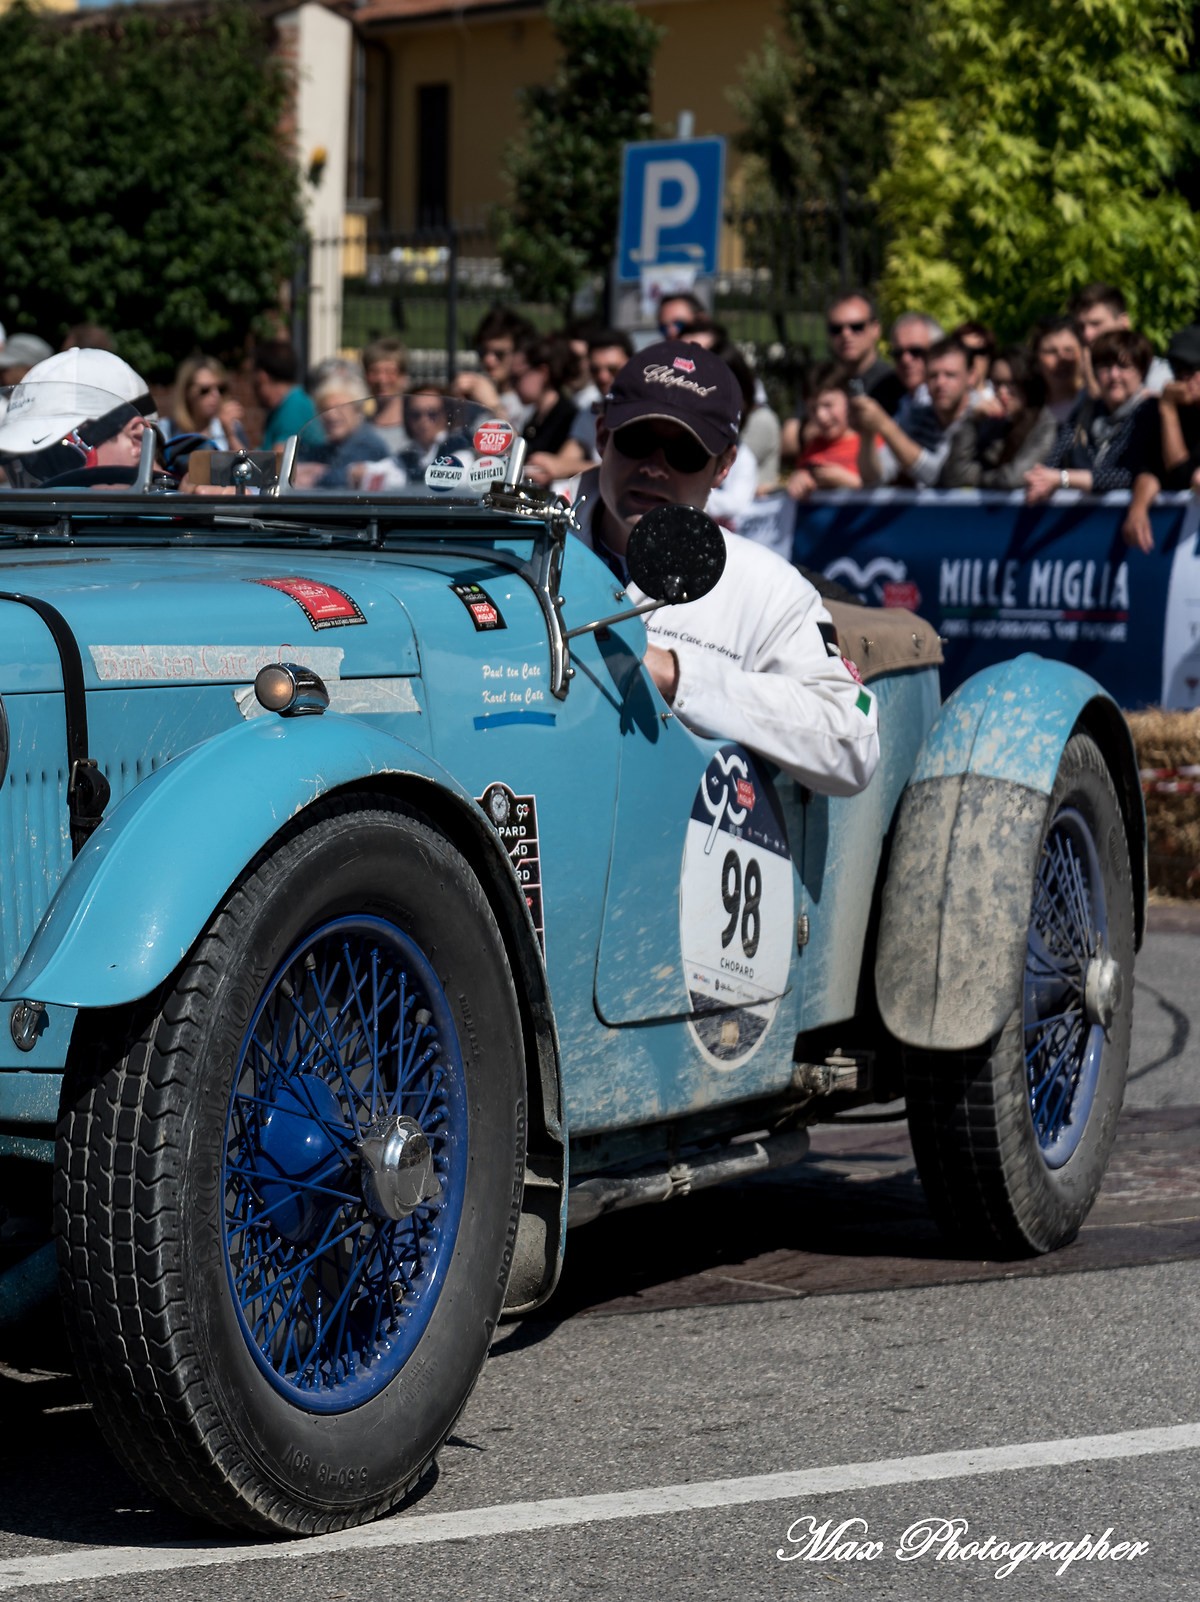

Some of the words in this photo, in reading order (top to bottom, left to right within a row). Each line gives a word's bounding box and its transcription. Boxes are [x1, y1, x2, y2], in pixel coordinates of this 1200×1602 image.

[639, 157, 700, 262] P
[643, 363, 717, 397] Chopard
[480, 432, 506, 445] 2015
[429, 469, 462, 480] VERIFICATO
[469, 466, 503, 481] VERIFICATO
[939, 557, 1017, 607] MILLE
[1029, 558, 1130, 609] MIGLIA
[474, 604, 490, 612] 1000
[663, 628, 678, 638] ten
[103, 645, 158, 679] Bank
[162, 651, 194, 678] ten
[482, 665, 503, 679] Paul
[507, 666, 519, 678] ten
[522, 663, 541, 680] Cate
[482, 690, 506, 704] Karel
[510, 691, 522, 702] ten
[525, 687, 544, 705] Cate
[721, 848, 763, 959] 98
[720, 957, 755, 979] CHOPARD
[317, 1463, 368, 1489] 5.50-18
